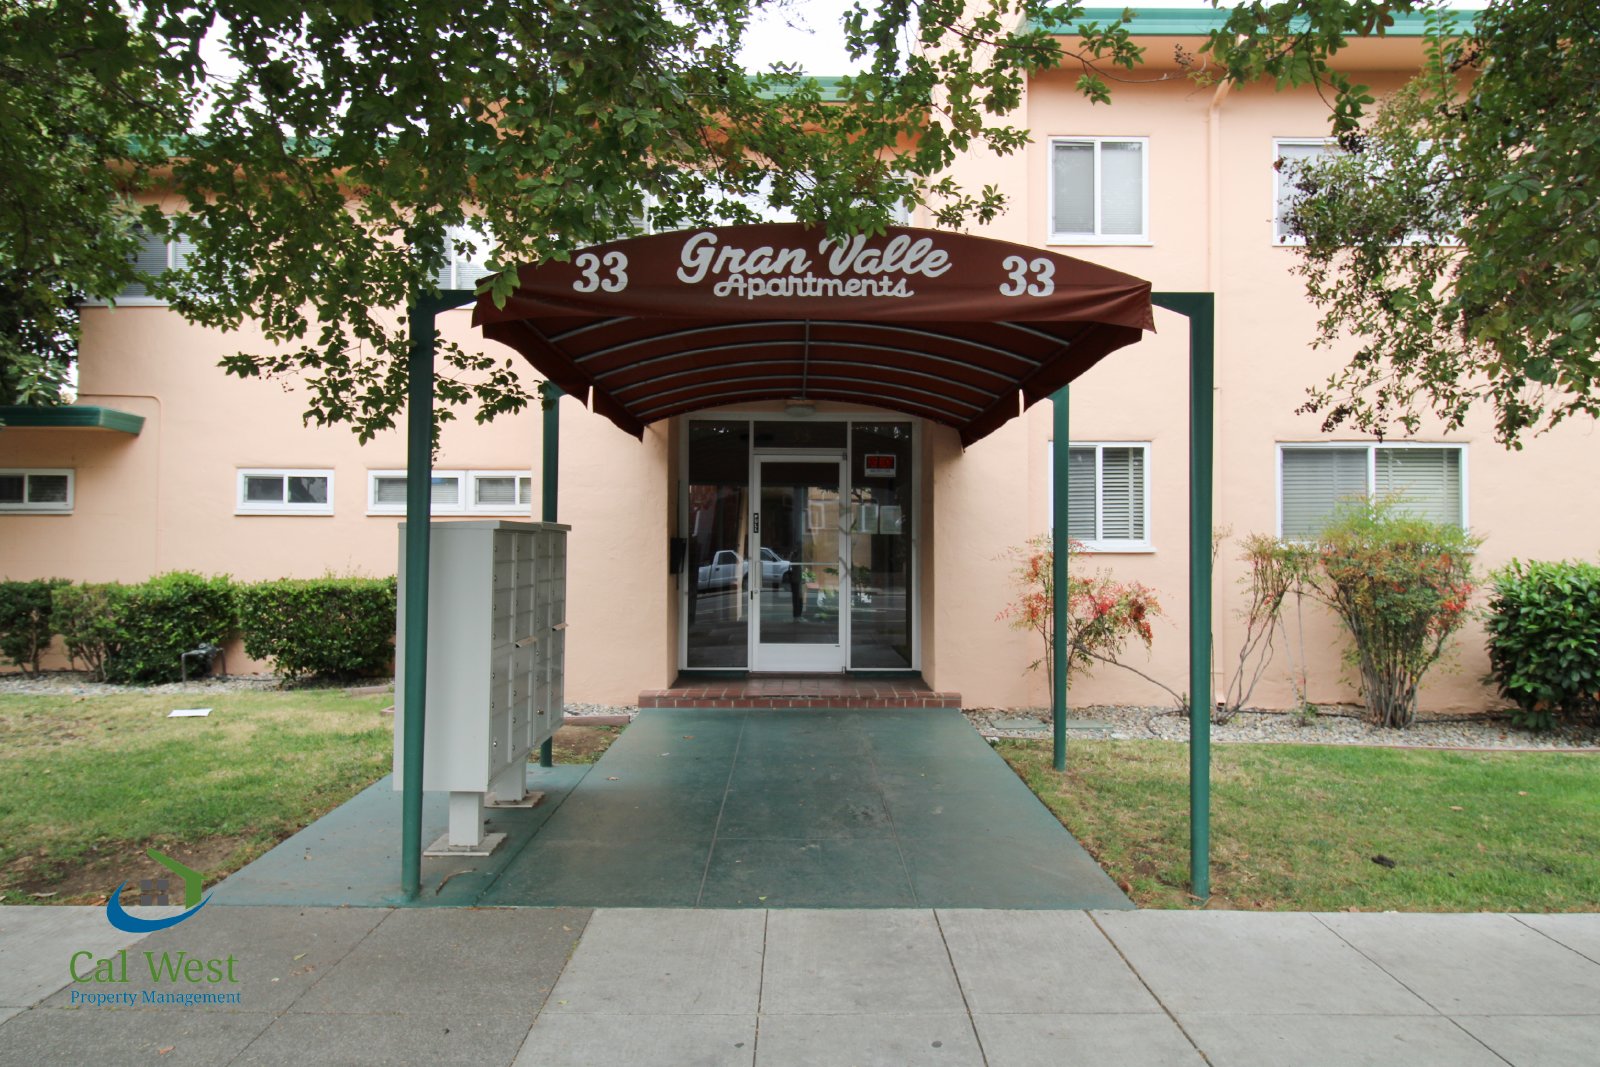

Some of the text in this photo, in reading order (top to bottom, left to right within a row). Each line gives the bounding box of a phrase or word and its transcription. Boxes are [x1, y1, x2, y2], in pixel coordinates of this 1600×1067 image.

[573, 252, 628, 293] 33
[676, 231, 952, 283] Gran Valle
[1000, 255, 1055, 297] 33
[713, 271, 915, 300] Apartments
